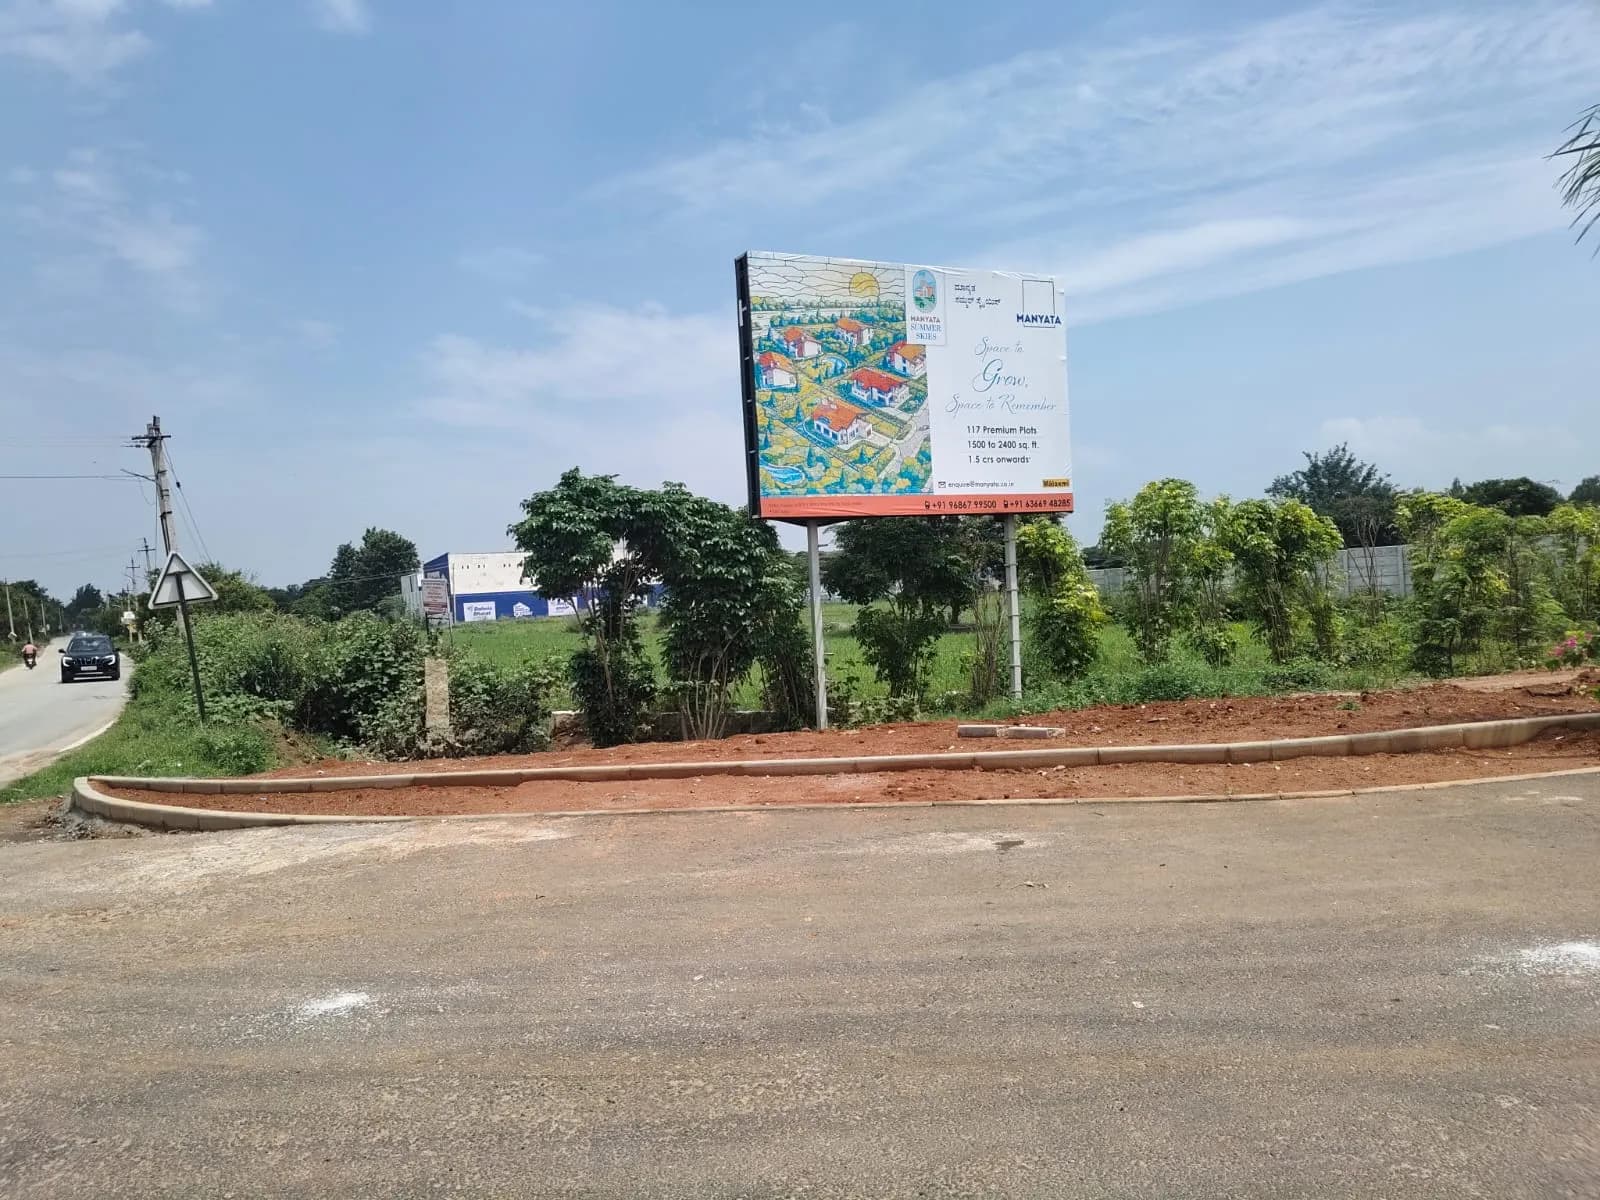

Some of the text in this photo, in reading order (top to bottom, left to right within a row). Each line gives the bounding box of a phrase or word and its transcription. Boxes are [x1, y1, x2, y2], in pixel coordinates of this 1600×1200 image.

[910, 315, 941, 323] MANYATA
[1016, 313, 1062, 325] MANYATA
[910, 323, 942, 332] SUMMER
[915, 332, 937, 341] SKIES
[975, 337, 1023, 361] Space to
[945, 393, 1056, 418] Space to Remember
[967, 425, 1037, 435] 117 Premium Plots
[967, 440, 1040, 451] 1500 to 2400 sq. ft.
[982, 455, 994, 464] crs
[932, 499, 997, 510] +91 96867 99500
[1009, 499, 1023, 509] +91
